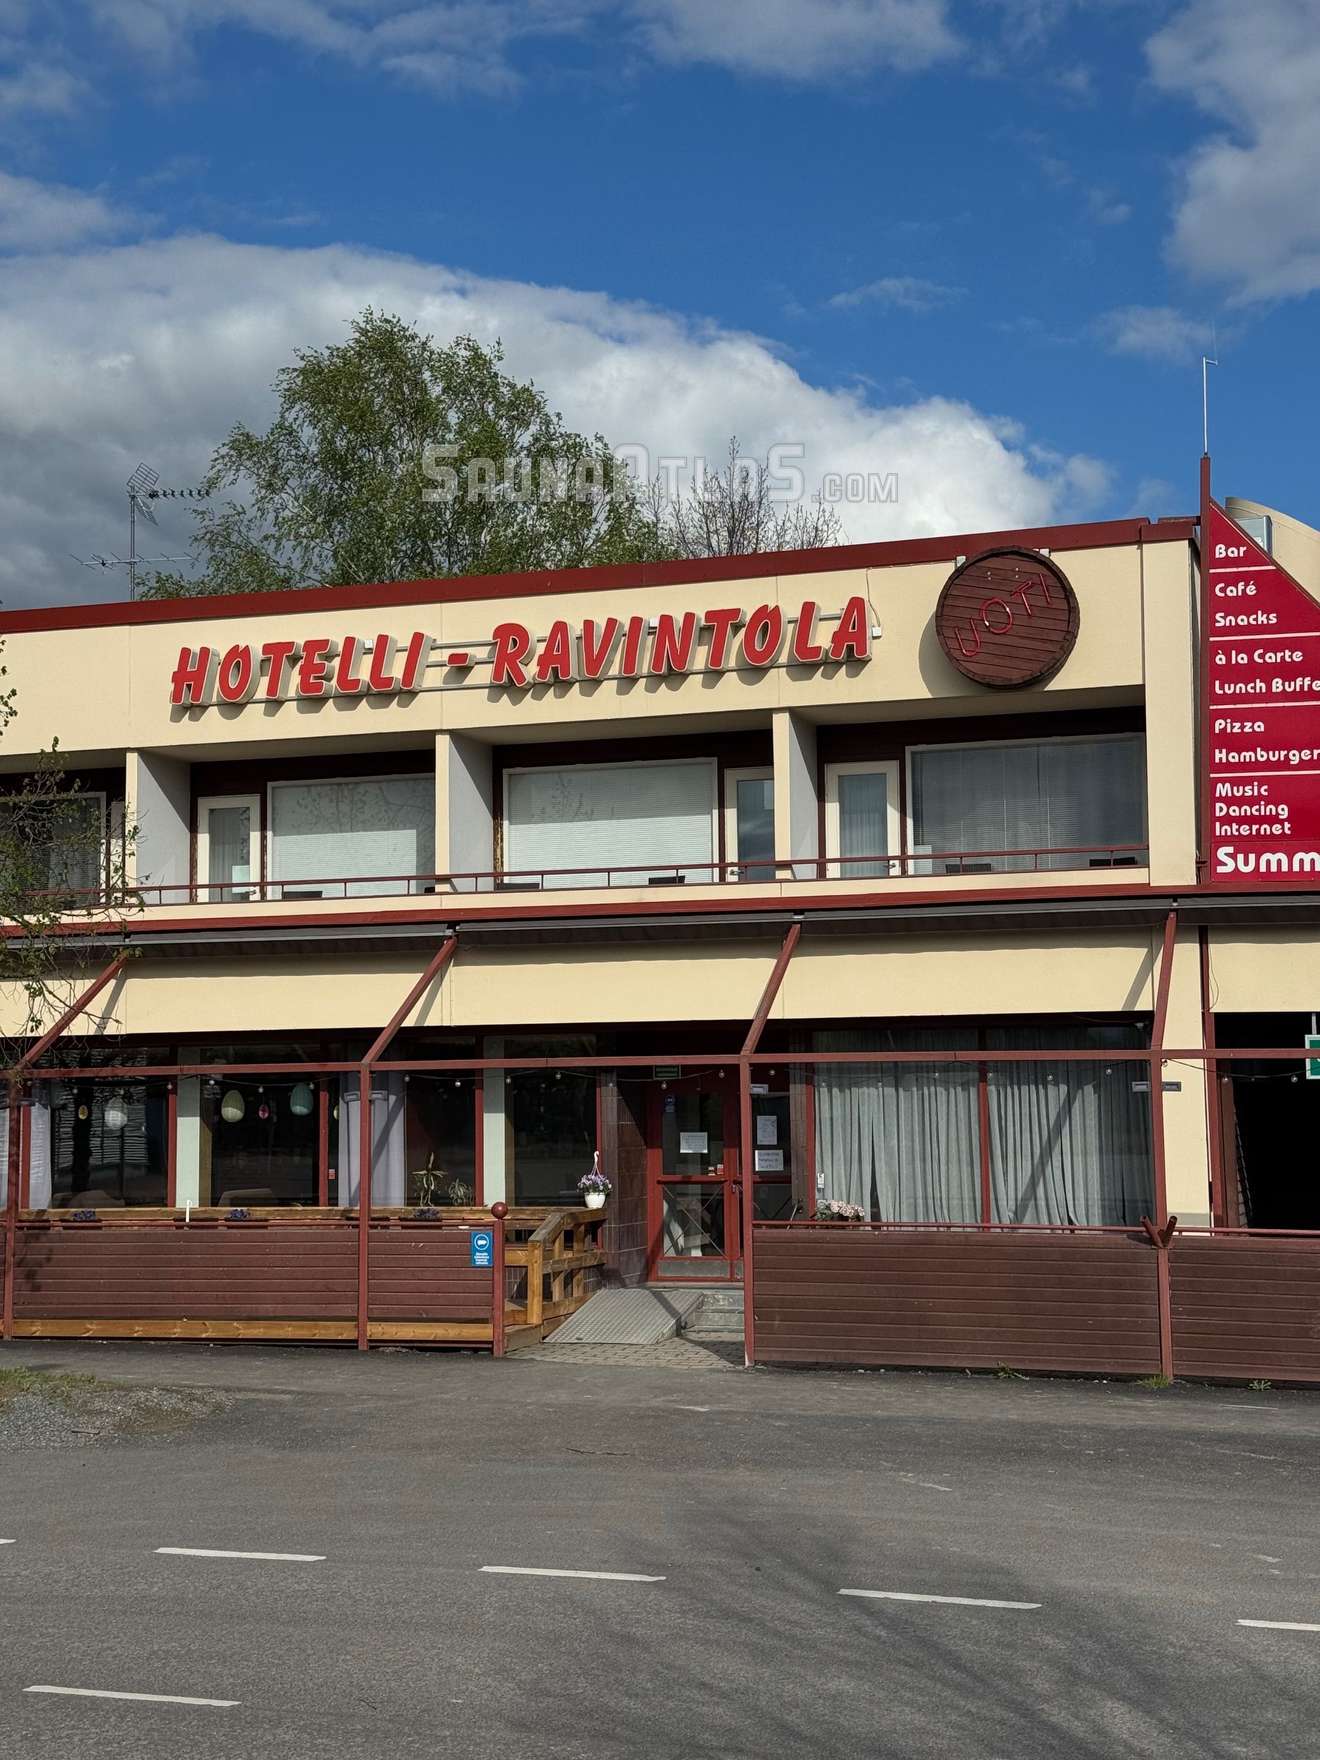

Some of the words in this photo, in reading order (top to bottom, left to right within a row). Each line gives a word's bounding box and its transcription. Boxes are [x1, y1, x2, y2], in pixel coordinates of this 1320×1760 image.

[1215, 543, 1247, 559] Bar
[1214, 580, 1257, 597] Café
[954, 573, 1053, 657] UOTI
[1215, 610, 1278, 627] Snacks
[171, 631, 426, 705] HOTELLI
[491, 596, 871, 687] RAVINTOLA
[1215, 650, 1226, 665] à
[1231, 650, 1248, 665] la
[1253, 648, 1304, 663] Carte
[1214, 678, 1267, 695] Lunch
[1271, 676, 1320, 693] Buffe
[1214, 718, 1265, 734] Pizza
[1214, 747, 1320, 765] Hamburger
[1215, 781, 1268, 797] Music
[1215, 801, 1289, 819] Dancing
[1215, 821, 1291, 836] Internet
[1216, 846, 1320, 873] Summ
